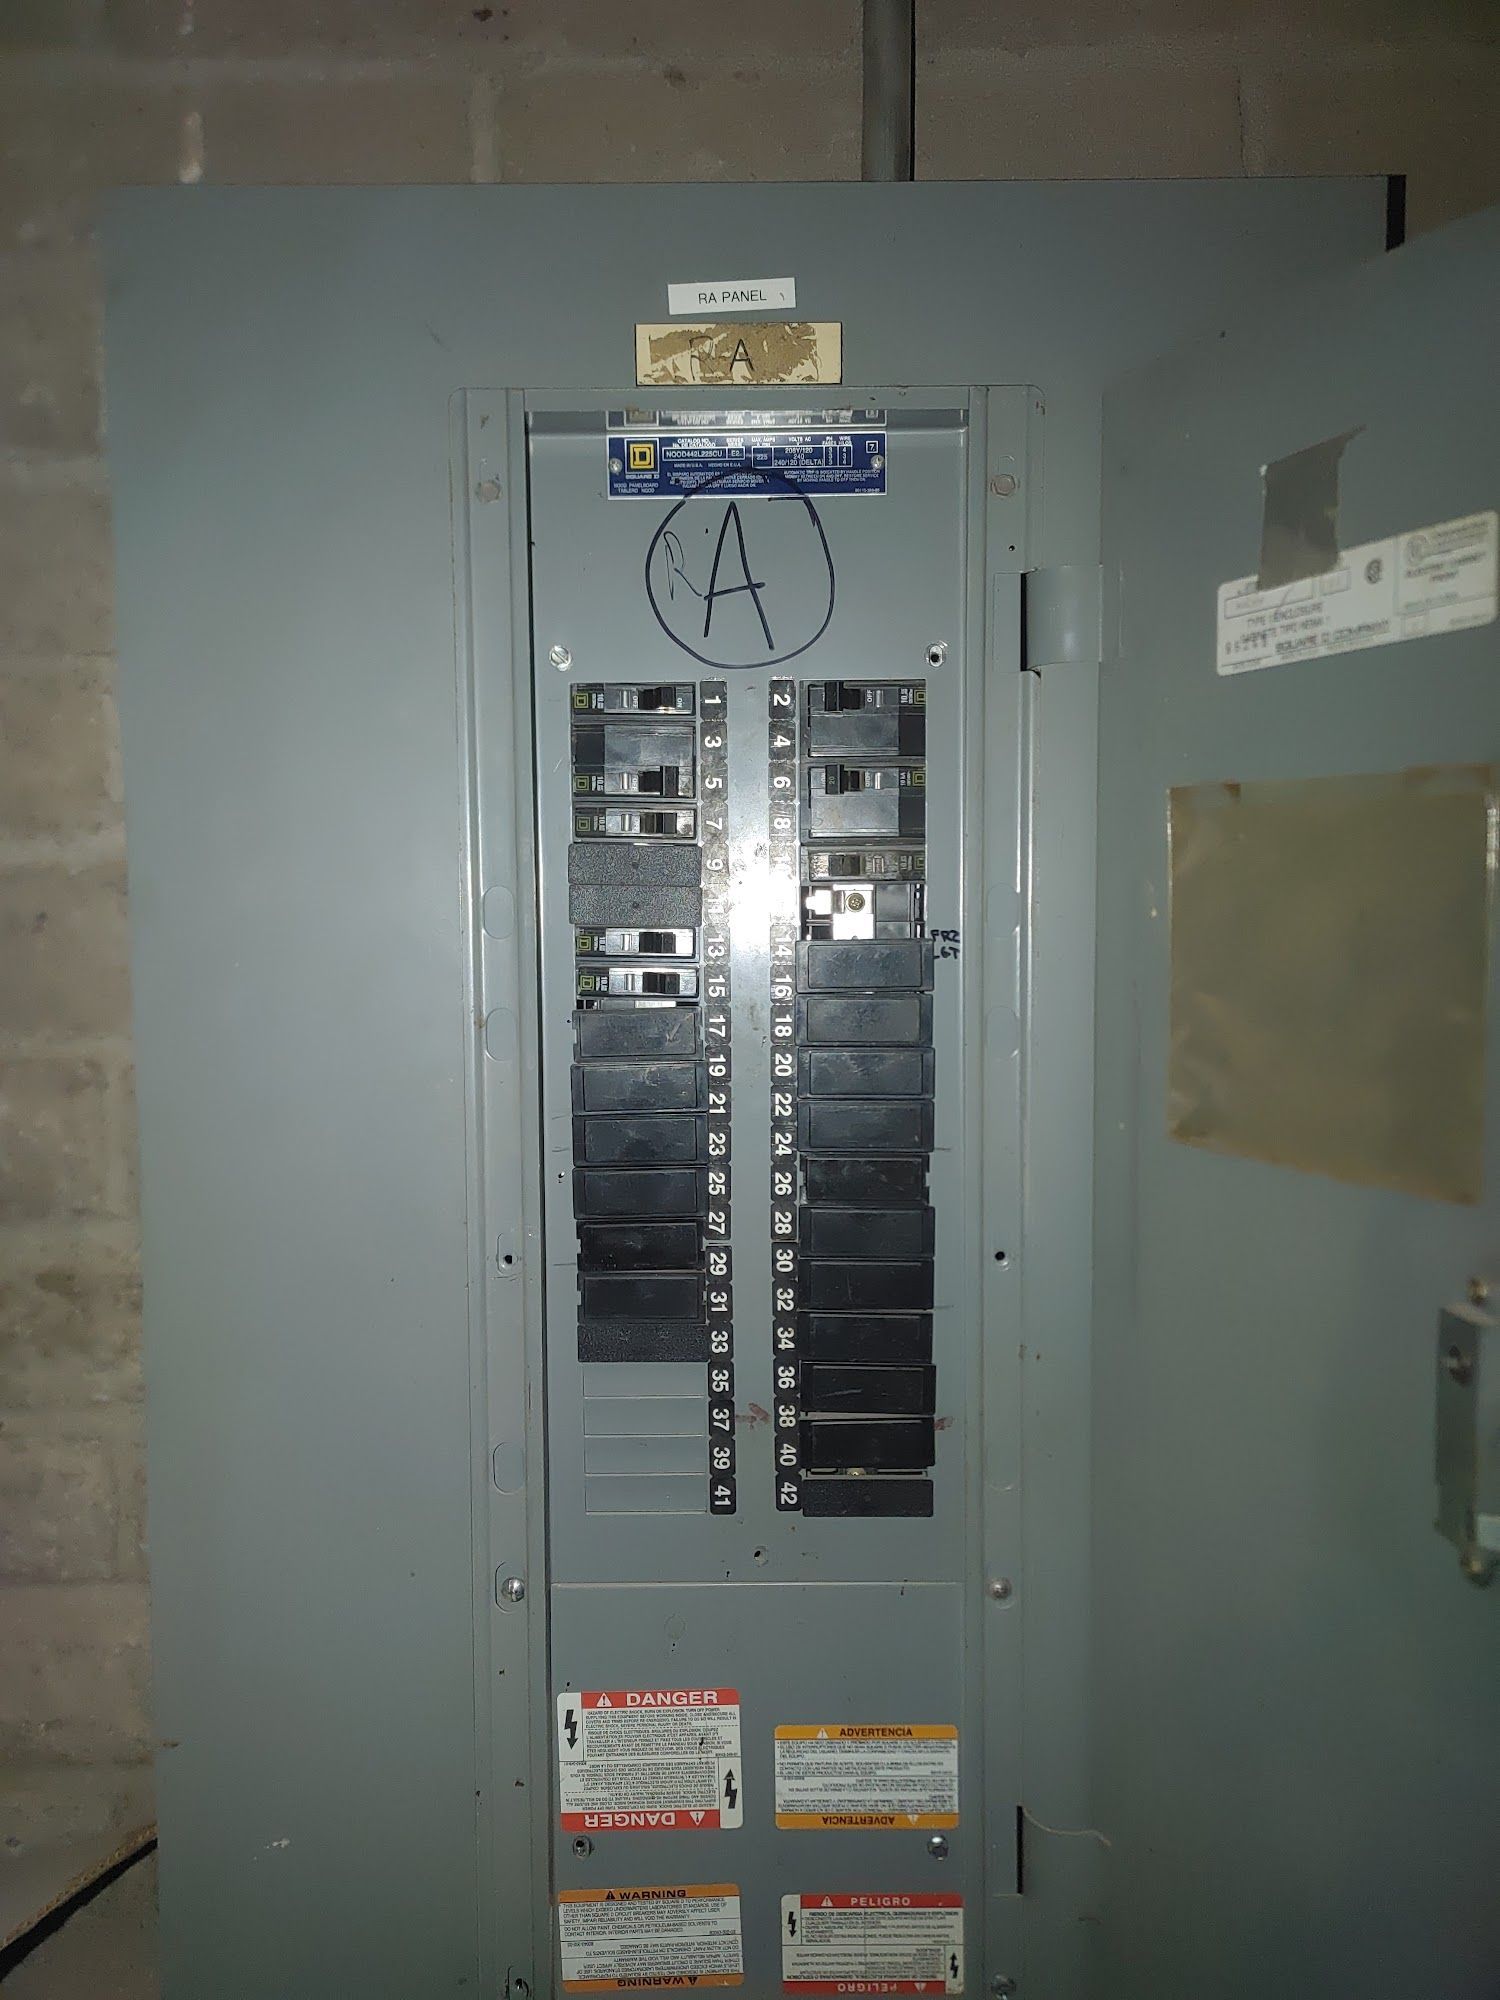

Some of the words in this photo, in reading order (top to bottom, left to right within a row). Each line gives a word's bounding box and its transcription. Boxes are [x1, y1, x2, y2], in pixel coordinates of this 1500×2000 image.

[698, 292, 717, 304] RA
[722, 290, 767, 302] PANEL
[705, 696, 721, 704] 1
[774, 694, 790, 706] 2
[705, 736, 722, 748] 3
[774, 735, 790, 747] 4
[705, 777, 722, 789] 5
[774, 776, 790, 788] 6
[706, 818, 722, 830] 7
[774, 818, 790, 829] 8
[707, 859, 723, 870] 9
[708, 934, 724, 958] 13
[775, 934, 792, 957] 14
[708, 975, 725, 998] 15
[774, 974, 792, 998] 16
[709, 1014, 726, 1037] 17
[775, 1014, 792, 1037] 18
[709, 1054, 726, 1077] 19
[775, 1054, 792, 1076] 20
[709, 1093, 726, 1114] 21
[775, 1093, 792, 1116] 22
[709, 1133, 726, 1156] 23
[775, 1133, 792, 1156] 24
[709, 1172, 725, 1195] 25
[775, 1172, 792, 1195] 26
[709, 1212, 725, 1234] 27
[775, 1212, 792, 1234] 28
[710, 1253, 727, 1276] 29
[776, 1249, 793, 1272] 30
[711, 1292, 728, 1312] 31
[777, 1288, 794, 1311] 32
[711, 1331, 728, 1353] 33
[777, 1327, 795, 1350] 34
[712, 1370, 729, 1392] 35
[778, 1366, 795, 1389] 36
[713, 1408, 730, 1431] 37
[779, 1405, 796, 1428] 38
[714, 1447, 730, 1470] 39
[780, 1444, 797, 1466] 40
[714, 1485, 731, 1506] 41
[780, 1482, 797, 1505] 42
[627, 1691, 718, 1706] DANGER
[840, 1728, 912, 1737] ADVERTENCIA
[585, 1812, 676, 1827] DANGER
[823, 1816, 895, 1825] ADVERTENCIA
[620, 1890, 686, 1900] WARNING
[850, 1897, 910, 1906] PELIGRO
[618, 1976, 684, 1986] WARNING
[837, 1983, 898, 1992] PELIGRO
